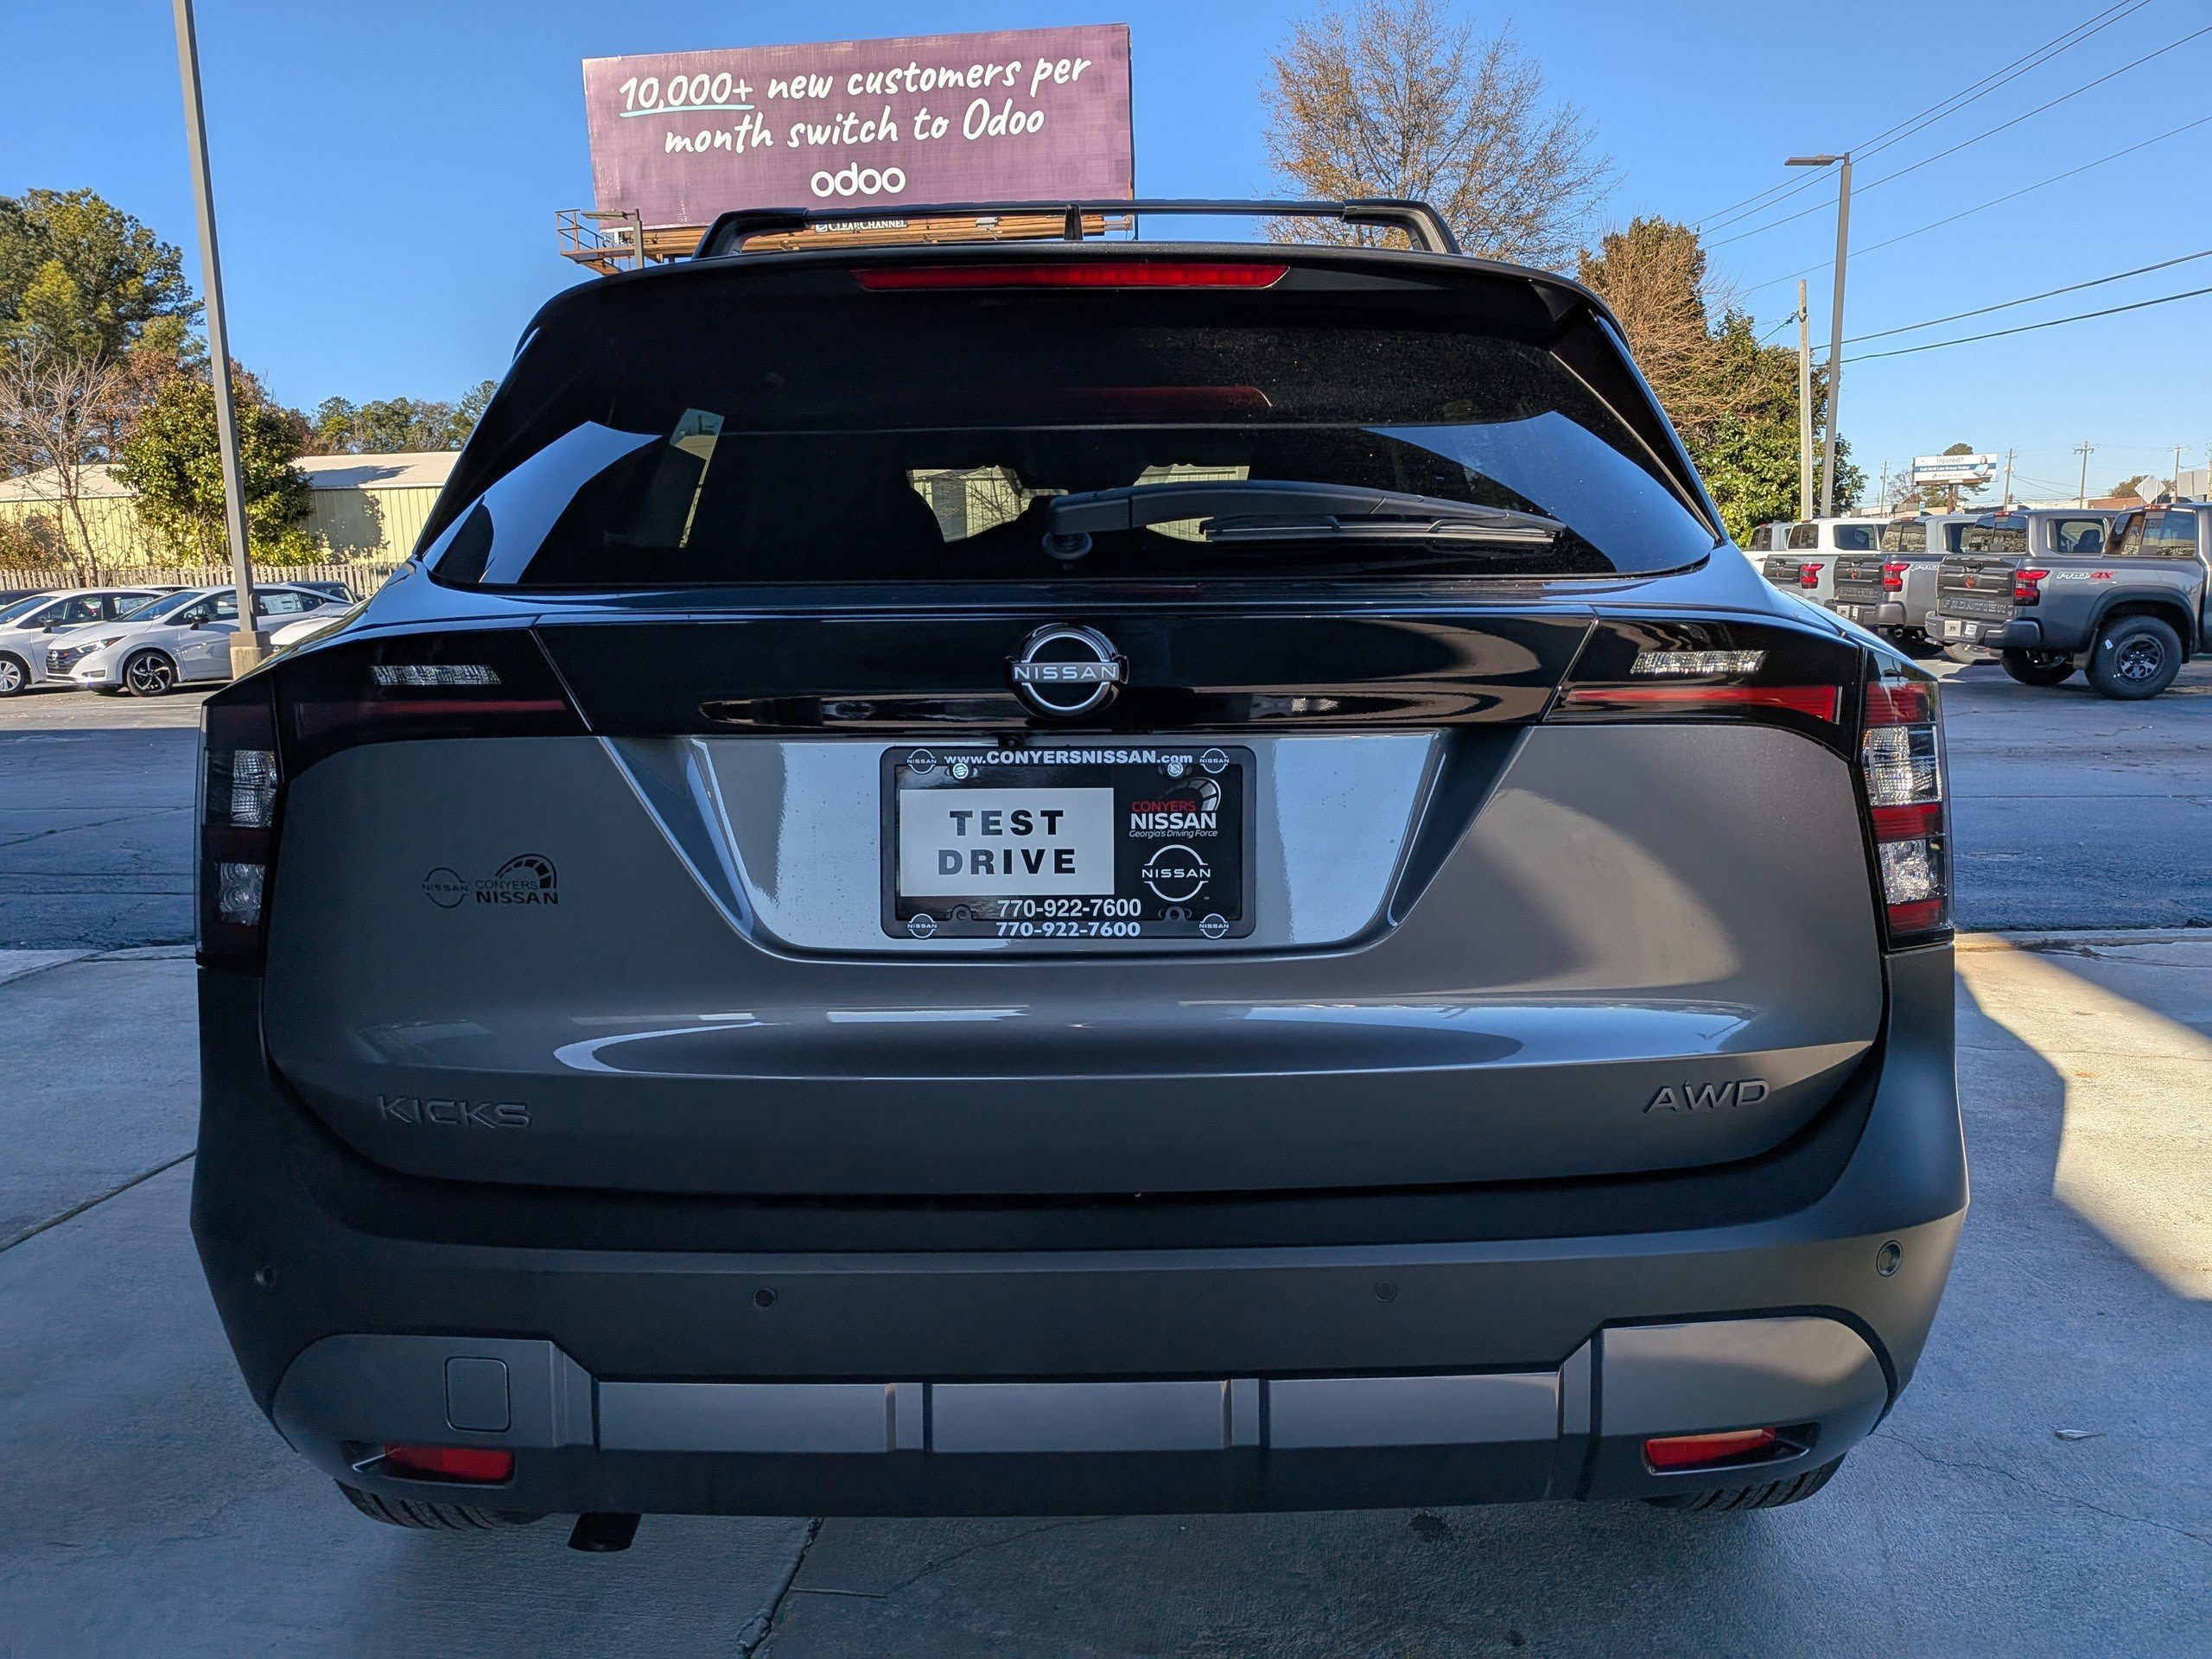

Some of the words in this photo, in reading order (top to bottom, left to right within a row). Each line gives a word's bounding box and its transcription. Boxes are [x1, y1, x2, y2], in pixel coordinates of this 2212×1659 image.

[619, 73, 753, 112] 10,000+
[767, 73, 833, 99] new
[847, 61, 1021, 95] customers
[1030, 57, 1092, 98] per
[664, 111, 773, 154] month
[786, 105, 899, 149] switch
[913, 107, 950, 140] to
[963, 98, 1045, 140] Odoo
[810, 162, 906, 197] odoo
[1944, 597, 2007, 613] FRONTIER
[1014, 665, 1117, 680] NISSAN
[944, 750, 1193, 765] www.CONYERSNISSAN.com
[1131, 800, 1197, 812] CONYERS
[950, 810, 1064, 836] TEST
[1130, 812, 1217, 830] NISSAN
[1128, 830, 1166, 839] Georgia's
[1166, 830, 1194, 839] Driving
[938, 849, 1077, 875] DRIVE
[1141, 868, 1211, 879] NISSAN
[422, 883, 469, 893] NISSAN
[475, 880, 538, 891] CONYERS
[475, 891, 559, 906] NISSAN
[997, 899, 1141, 918] 770-922-7600
[995, 922, 1141, 938] 770-922-7600
[1643, 1078, 1770, 1115] AWD
[378, 1093, 532, 1129] KICKS
